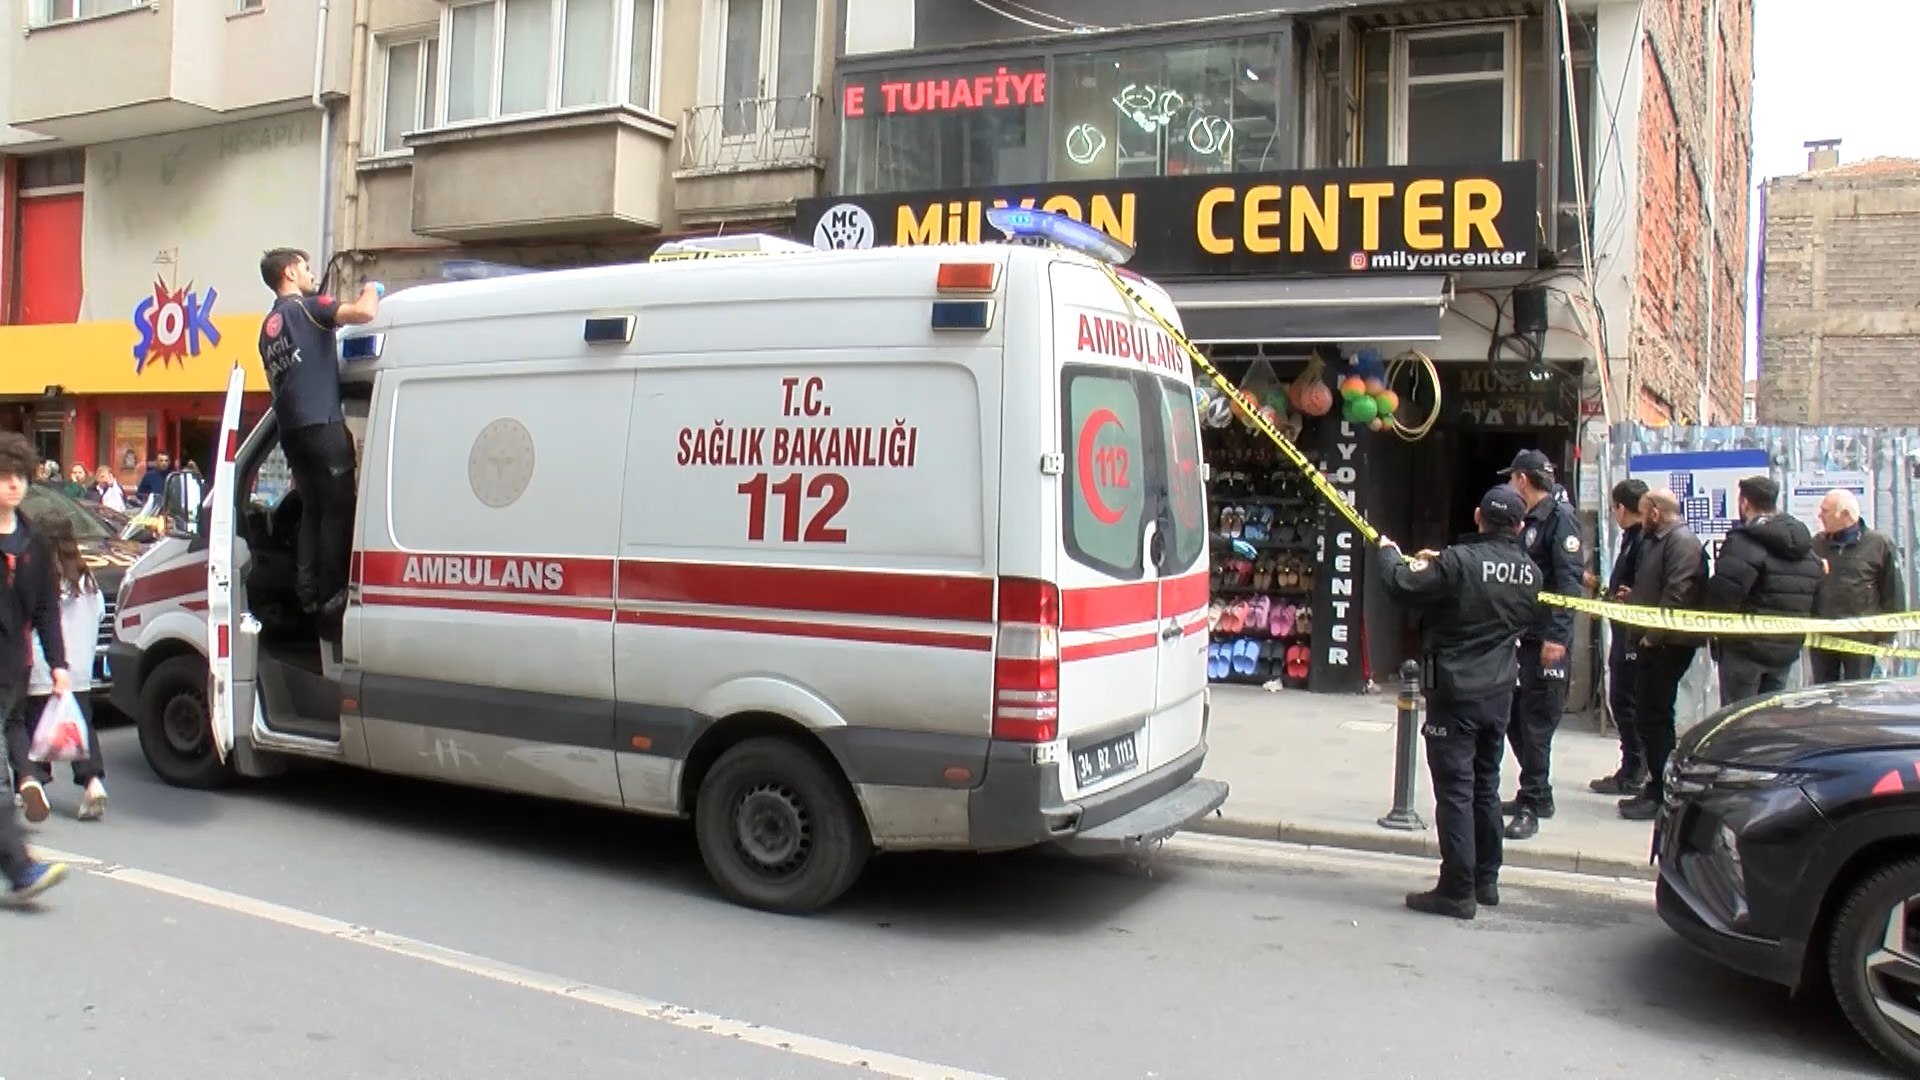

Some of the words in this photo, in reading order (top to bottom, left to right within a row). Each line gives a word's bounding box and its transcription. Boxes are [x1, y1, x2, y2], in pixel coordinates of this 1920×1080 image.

[845, 86, 865, 117] E
[881, 66, 1046, 114] TUHAFİYE
[831, 210, 858, 228] MC
[1196, 177, 1505, 255] CENTER
[1371, 250, 1527, 271] milyoncenter
[1077, 312, 1184, 374] AMBULANS
[782, 376, 832, 417] T.C.
[677, 418, 766, 466] SAĞLIK
[772, 417, 918, 467] BAKANLIĞI
[1095, 446, 1131, 489] 112
[737, 472, 850, 544] 112
[403, 555, 564, 590] AMBULANS
[1328, 532, 1353, 665] CENTER
[1078, 753, 1092, 778] 34
[1097, 746, 1112, 773] BZ
[1114, 738, 1134, 765] 1113
